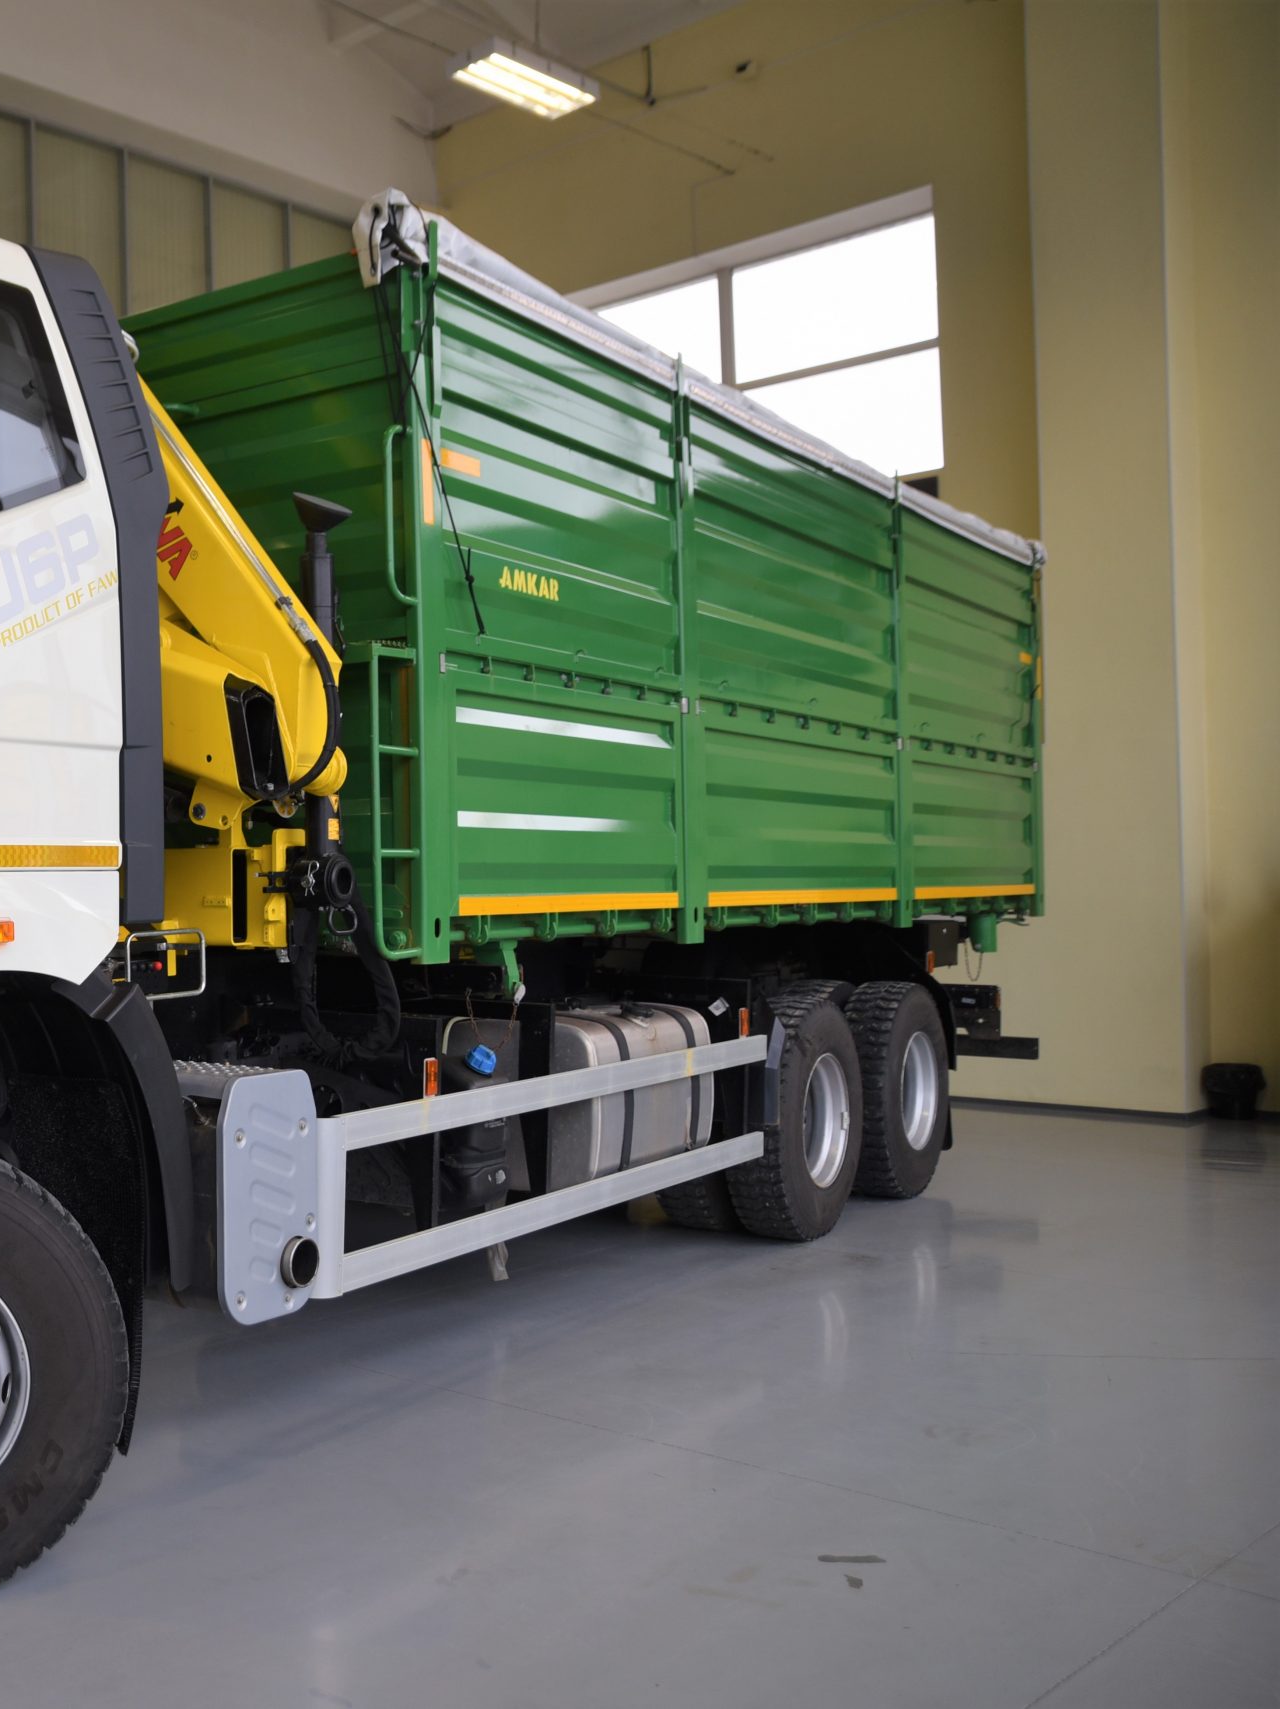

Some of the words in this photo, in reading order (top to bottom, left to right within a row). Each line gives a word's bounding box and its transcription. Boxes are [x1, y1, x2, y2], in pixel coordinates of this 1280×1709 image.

[65, 587, 84, 610] OF
[88, 568, 118, 599] FAW
[498, 565, 559, 601] AMKAR
